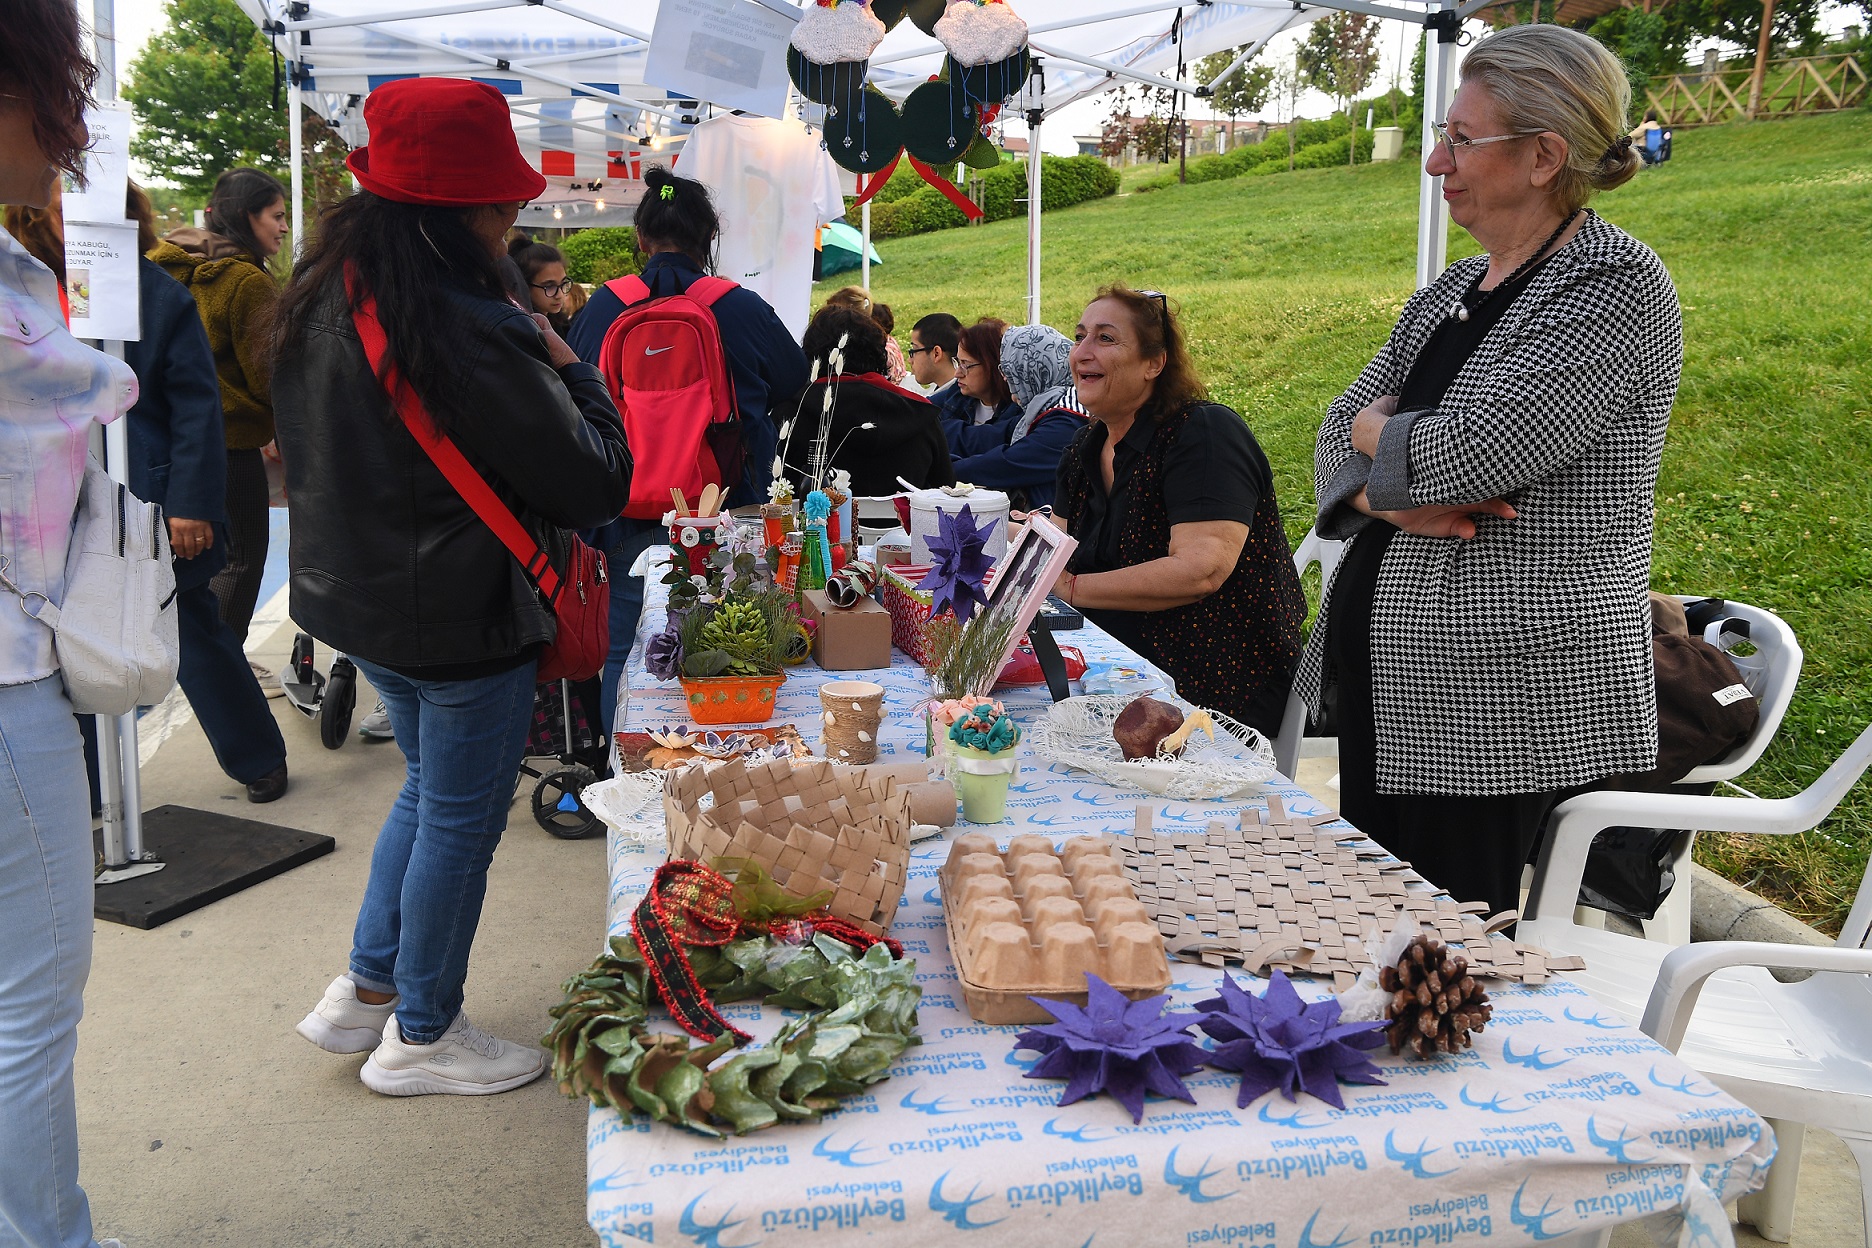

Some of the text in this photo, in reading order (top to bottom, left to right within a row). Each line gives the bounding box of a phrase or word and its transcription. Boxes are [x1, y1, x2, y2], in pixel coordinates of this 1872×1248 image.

[1547, 1070, 1629, 1091] Belediyesi
[1327, 1098, 1448, 1120] Beylikdüzü
[1355, 1091, 1437, 1104] Belediyesi
[1147, 1108, 1233, 1125] Belediyesi
[1480, 1120, 1564, 1137] Belediyesi
[928, 1120, 1018, 1138] Belediyesi
[693, 1143, 788, 1161] Belediyesi
[888, 1130, 1024, 1156] Beylikdüzü
[1271, 1135, 1359, 1152] Belediyesi
[1453, 1134, 1576, 1159] Beylikdüzü
[649, 1153, 791, 1177] Beylikdüzü
[1046, 1152, 1139, 1177] Belediyesi
[1237, 1148, 1368, 1181] Beylikdüzü
[1605, 1163, 1683, 1189] Belediyesi
[806, 1180, 904, 1200] Belediyesi
[1006, 1172, 1144, 1209] Beylikdüzü
[761, 1197, 906, 1233] Beylikdüzü
[1409, 1193, 1489, 1221] Belediyesi
[1187, 1222, 1276, 1247] Belediyesi
[1370, 1213, 1493, 1247] Beylikdüzü
